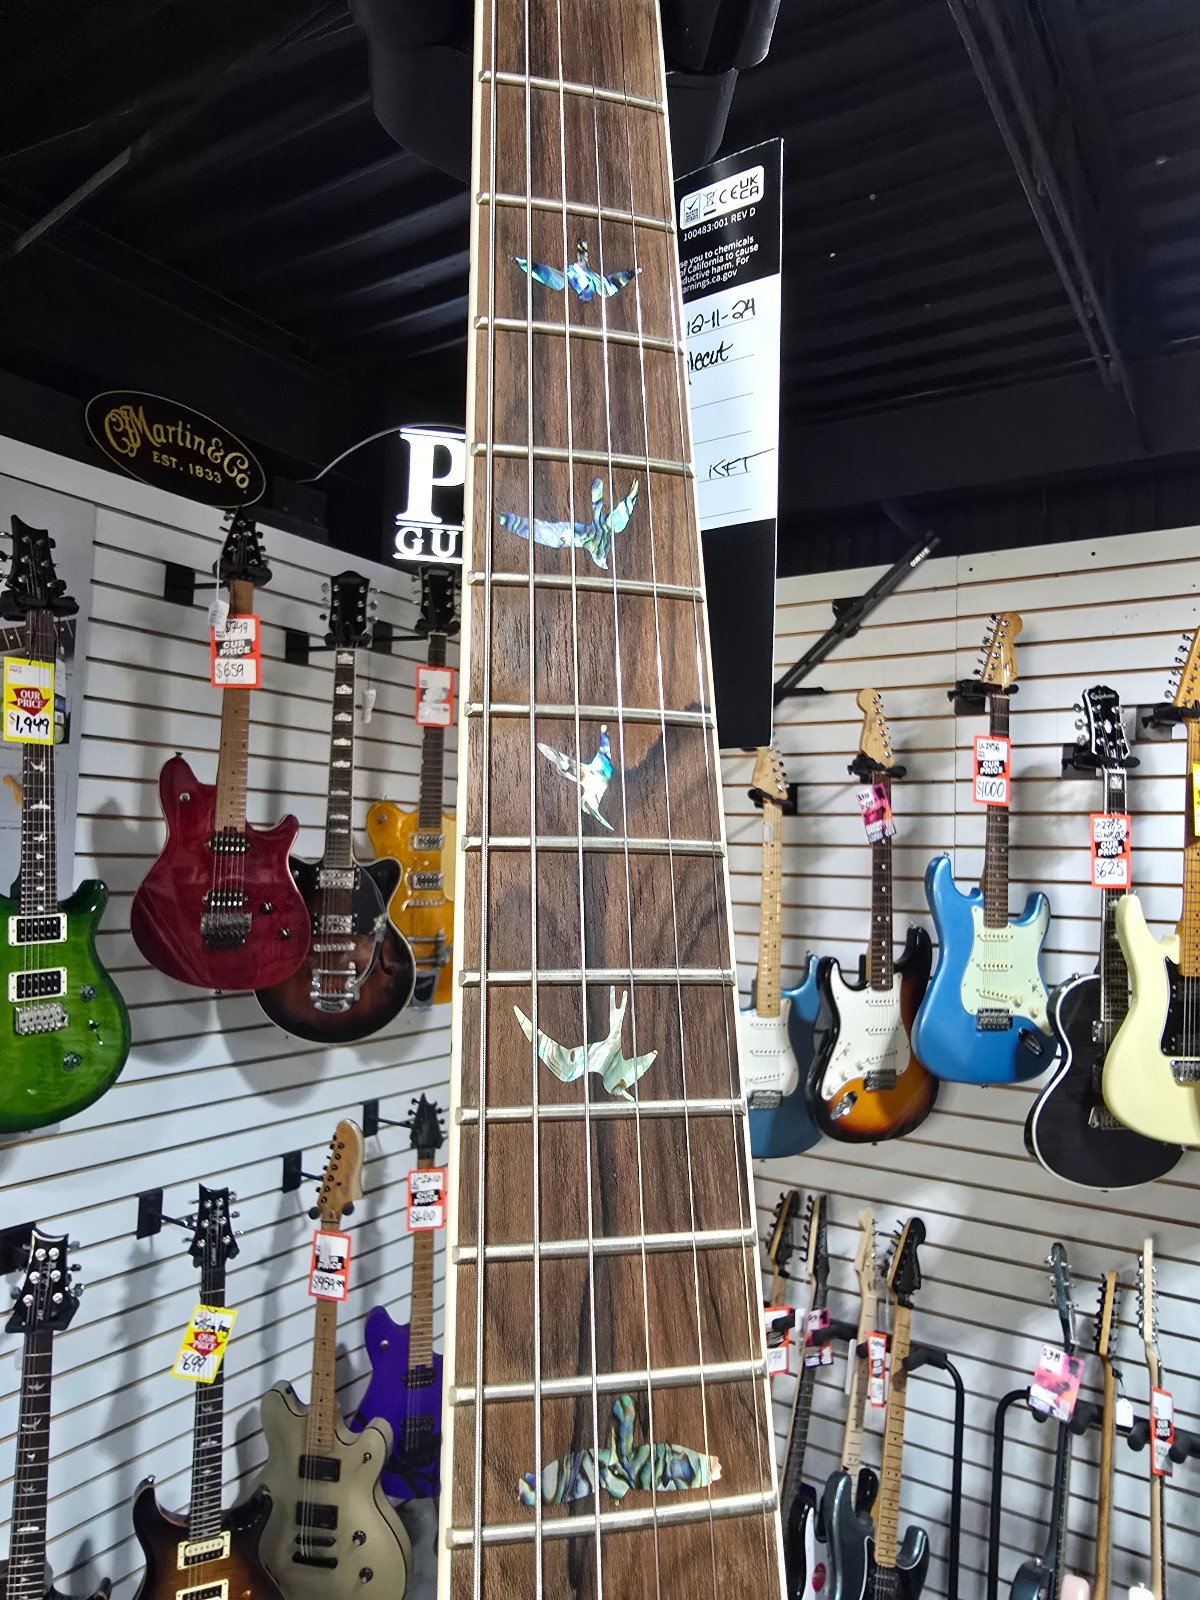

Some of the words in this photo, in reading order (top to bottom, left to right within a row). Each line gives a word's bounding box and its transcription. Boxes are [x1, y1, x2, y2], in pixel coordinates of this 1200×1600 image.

[740, 173, 759, 189] UK
[740, 185, 760, 200] CA
[683, 217, 729, 242] 100483:001
[730, 209, 748, 224] REV
[749, 207, 756, 217] D
[687, 255, 724, 275] California
[725, 252, 734, 261] to
[735, 243, 759, 257] cause
[689, 254, 704, 269] you
[705, 251, 713, 260] to
[714, 235, 754, 256] chemicals
[711, 261, 734, 275] harm.
[735, 256, 750, 267] For
[687, 298, 756, 337] 12-11-24
[152, 450, 184, 472] EST.
[188, 463, 223, 485] 1833
[219, 645, 251, 657] PRICE
[222, 639, 246, 649] OUR
[216, 662, 244, 679] $659
[20, 689, 41, 700] OUR
[17, 698, 44, 709] PRICE
[9, 712, 50, 735] $1,949
[979, 766, 1004, 776] PRICE
[982, 760, 1000, 768] OUR
[976, 780, 1005, 799] $1000
[1097, 846, 1123, 857] PRICE
[1100, 841, 1119, 850] OUR
[1096, 860, 1125, 879] $625
